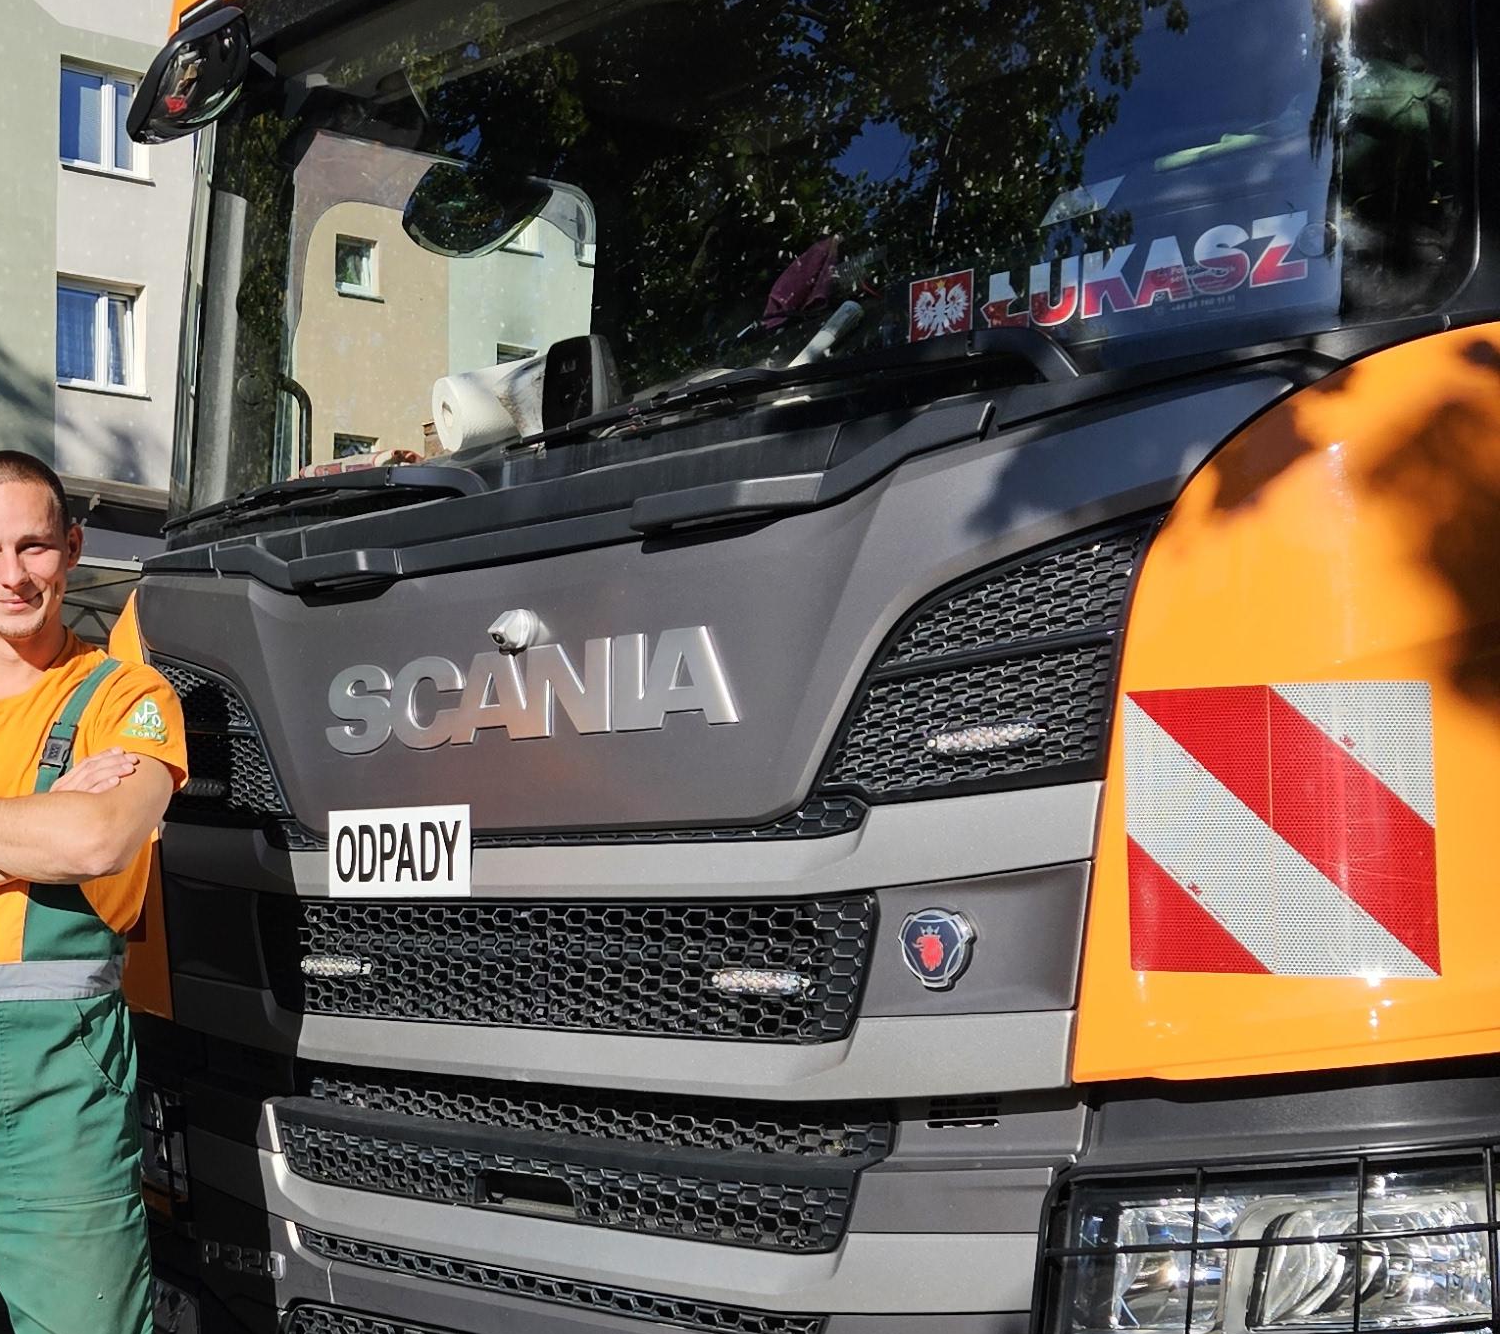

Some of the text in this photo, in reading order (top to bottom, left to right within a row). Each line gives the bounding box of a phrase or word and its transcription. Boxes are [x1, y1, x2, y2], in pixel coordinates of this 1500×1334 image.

[980, 210, 1308, 328] ŁUKASZ
[326, 625, 740, 755] SCANIA
[336, 820, 462, 883] ODPADY
[221, 1244, 287, 1282] 320
